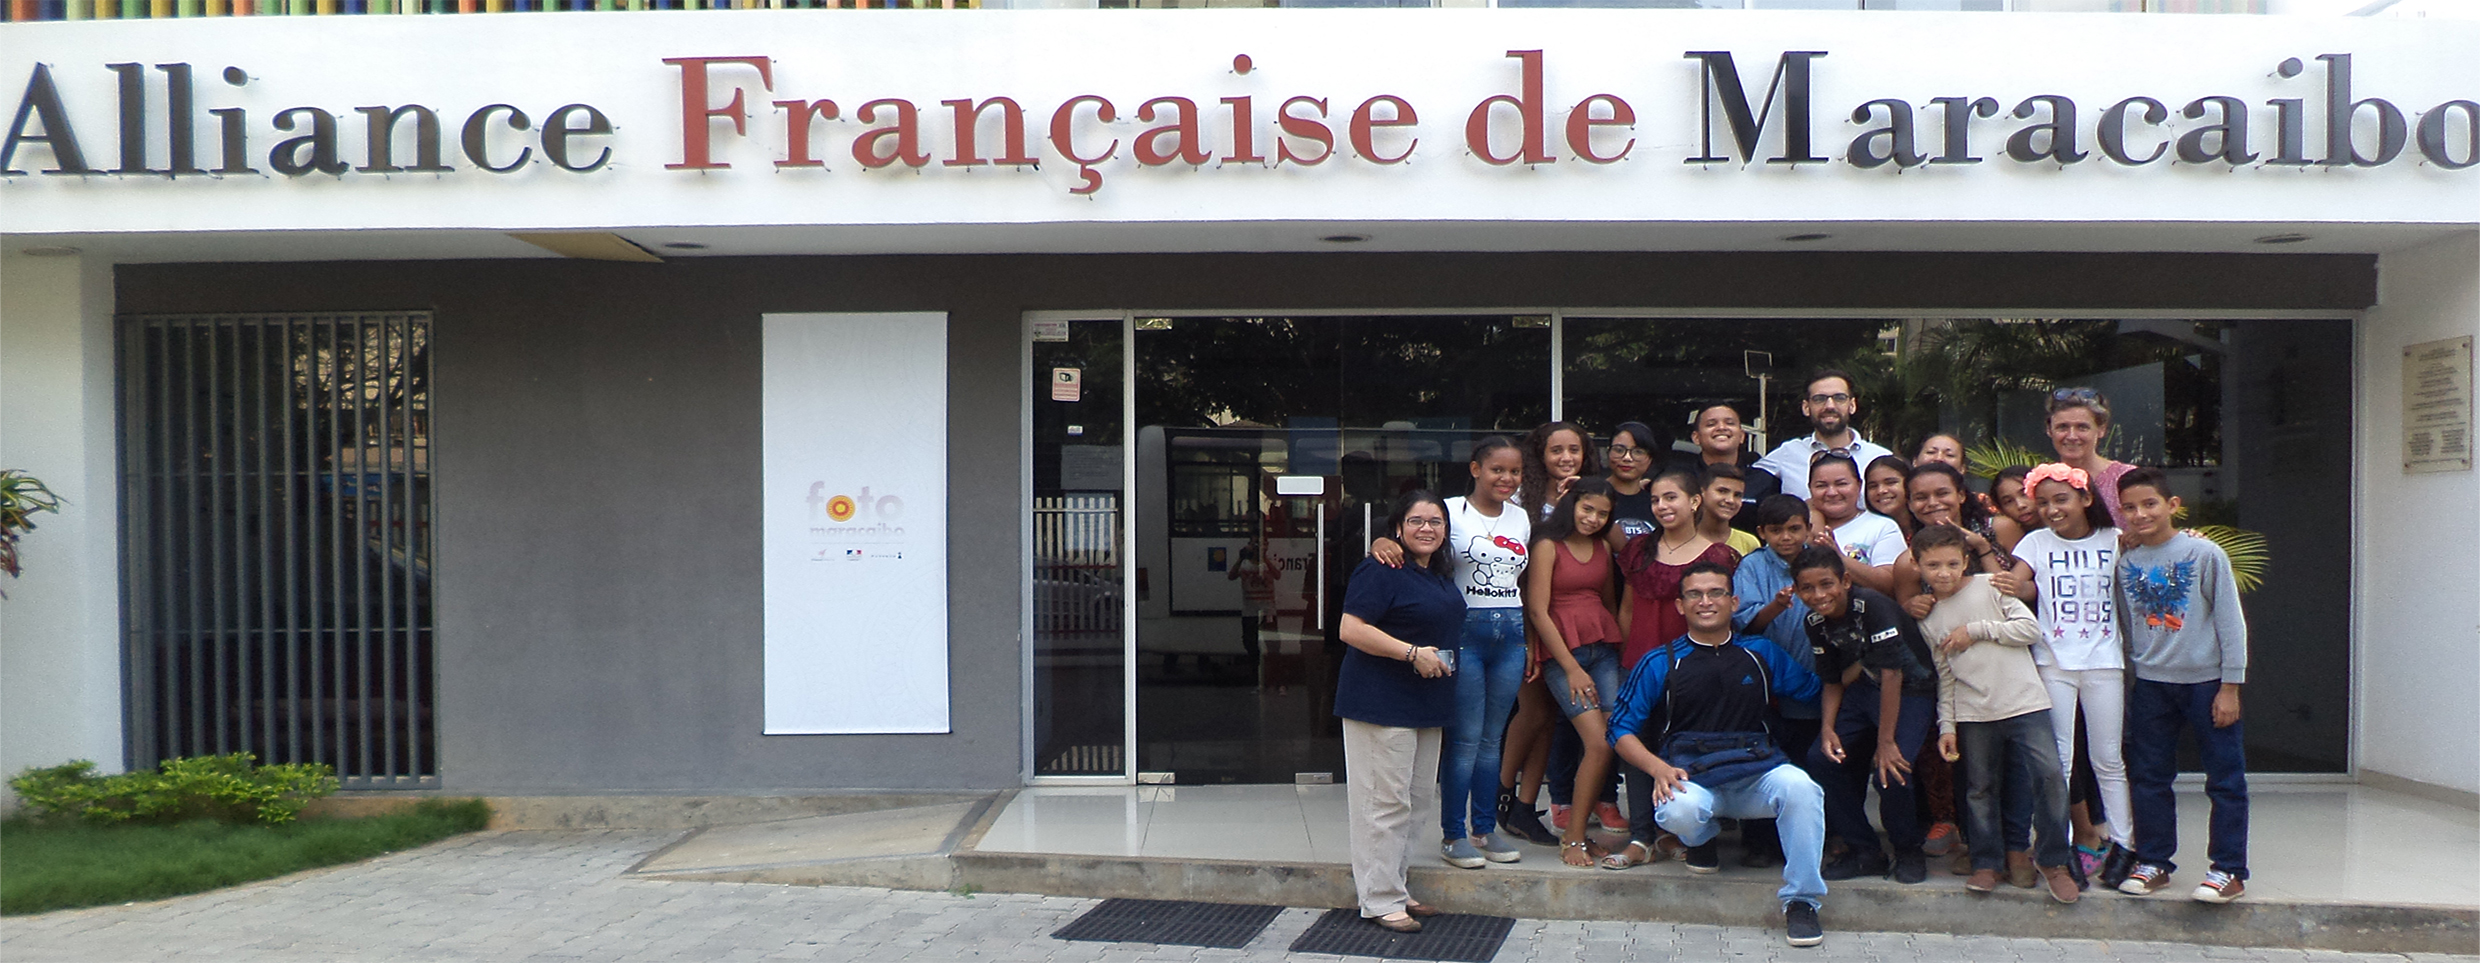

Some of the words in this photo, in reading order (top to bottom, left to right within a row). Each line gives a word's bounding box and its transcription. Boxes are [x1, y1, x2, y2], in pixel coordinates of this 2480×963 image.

[0, 61, 613, 176] Alliance
[661, 53, 1419, 194] Française
[1465, 49, 1637, 166] de
[1684, 51, 2480, 170] Maracaibo
[806, 480, 905, 522] foto
[1625, 526, 1642, 535] BTS
[2049, 550, 2112, 570] HILF
[2051, 574, 2111, 599] IGER
[2052, 600, 2111, 623] 1985
